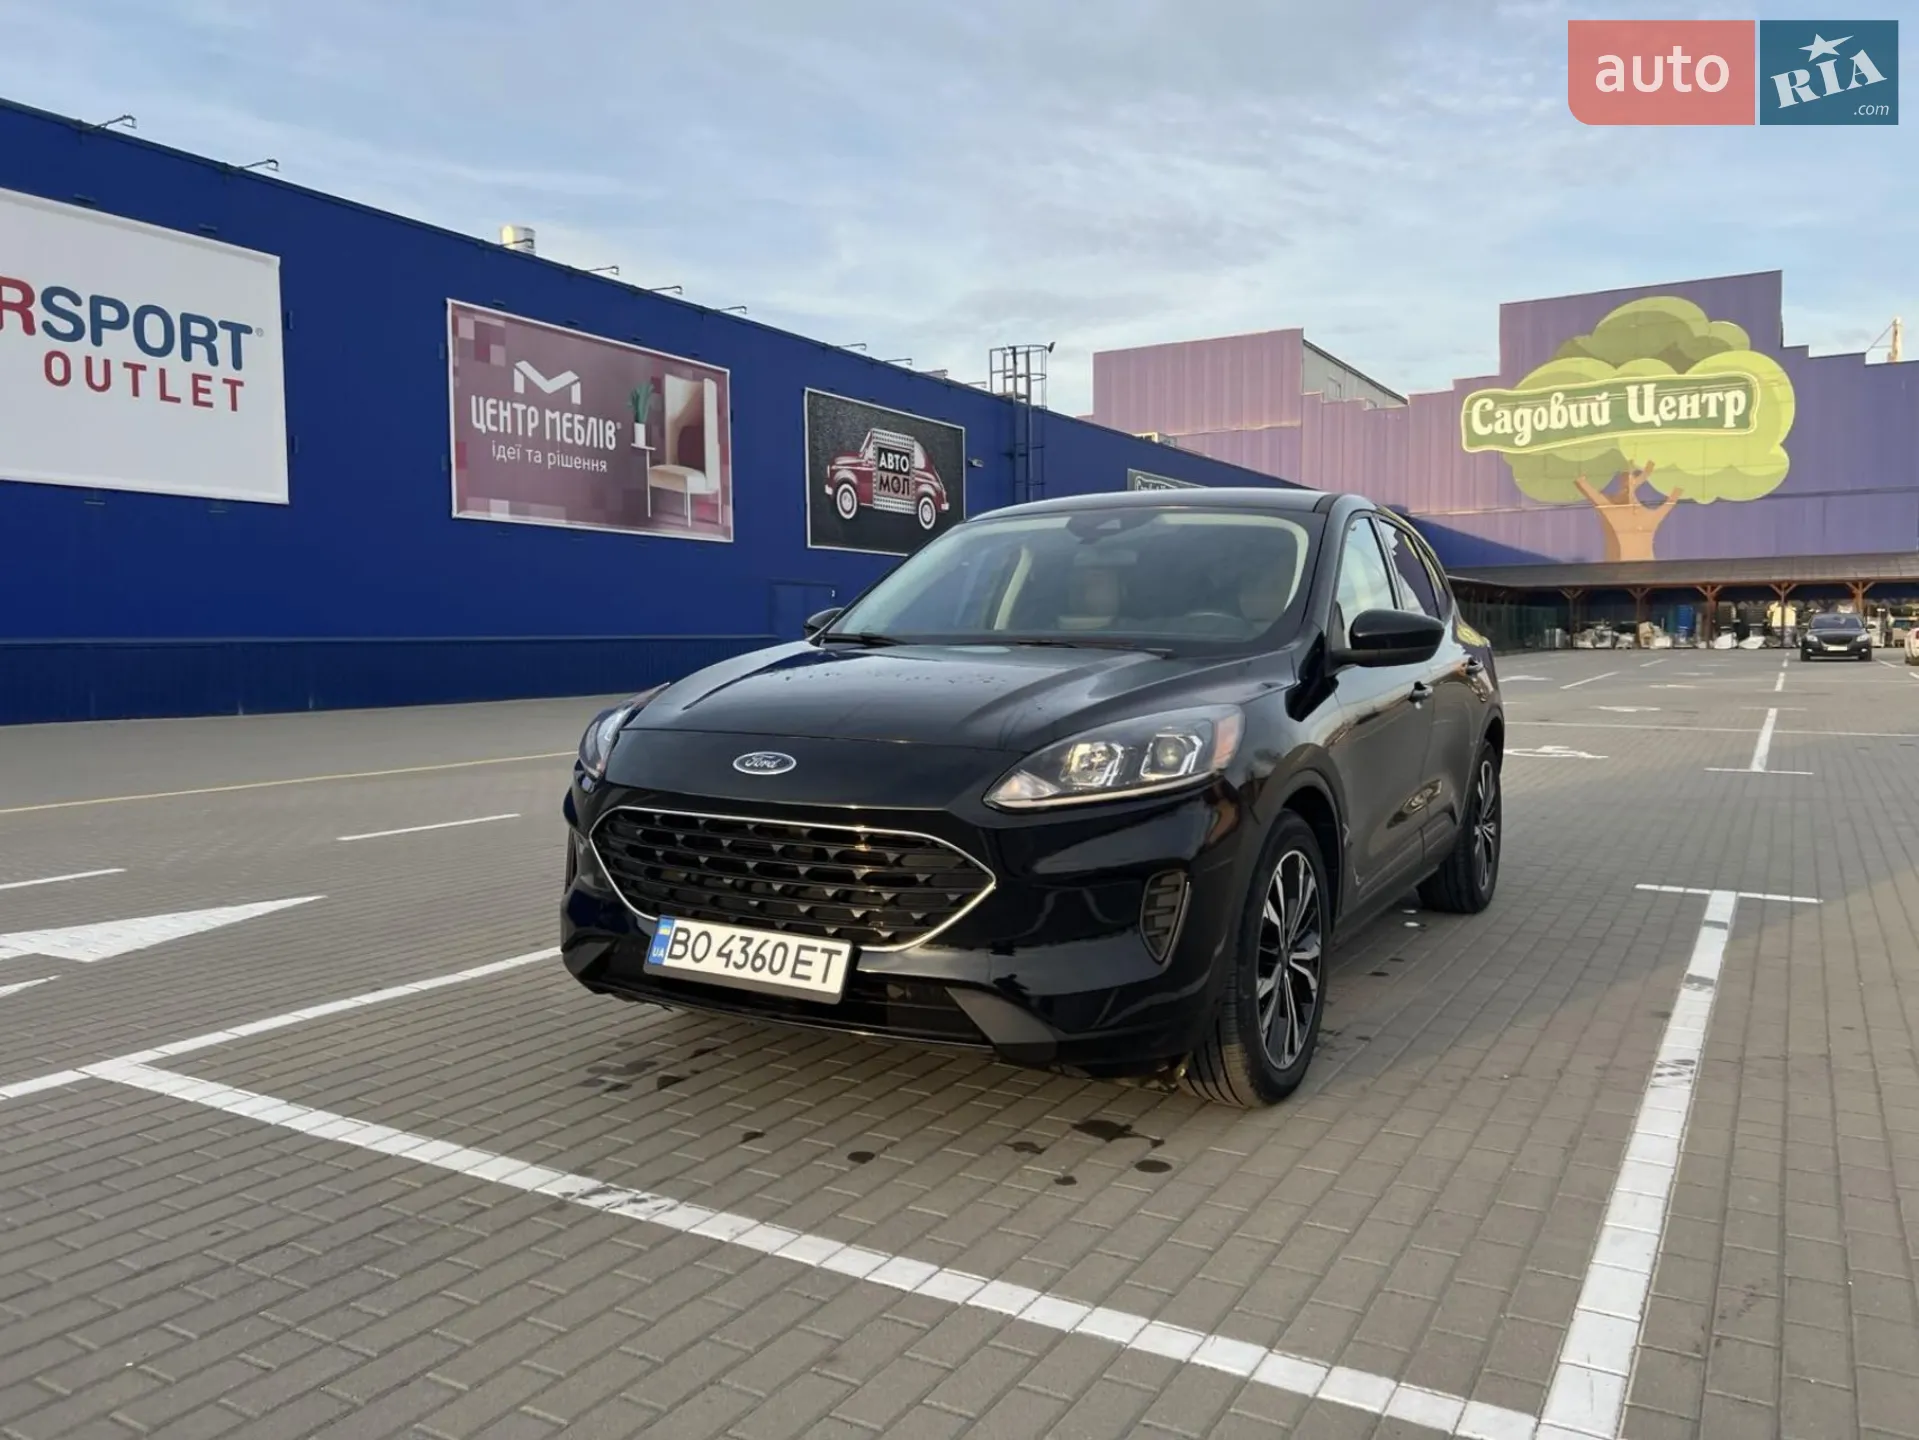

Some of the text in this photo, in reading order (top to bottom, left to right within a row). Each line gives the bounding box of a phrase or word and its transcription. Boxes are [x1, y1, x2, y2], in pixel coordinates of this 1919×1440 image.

[44, 350, 245, 412] OUTLET
[470, 394, 617, 451] ЦЕНТР МЕБЛІВ
[1471, 383, 1747, 446] Садовий Центр
[491, 440, 608, 473] ідеї та рішення
[879, 451, 910, 473] АВТО
[879, 474, 910, 496] МОЛ
[744, 754, 782, 769] Ford
